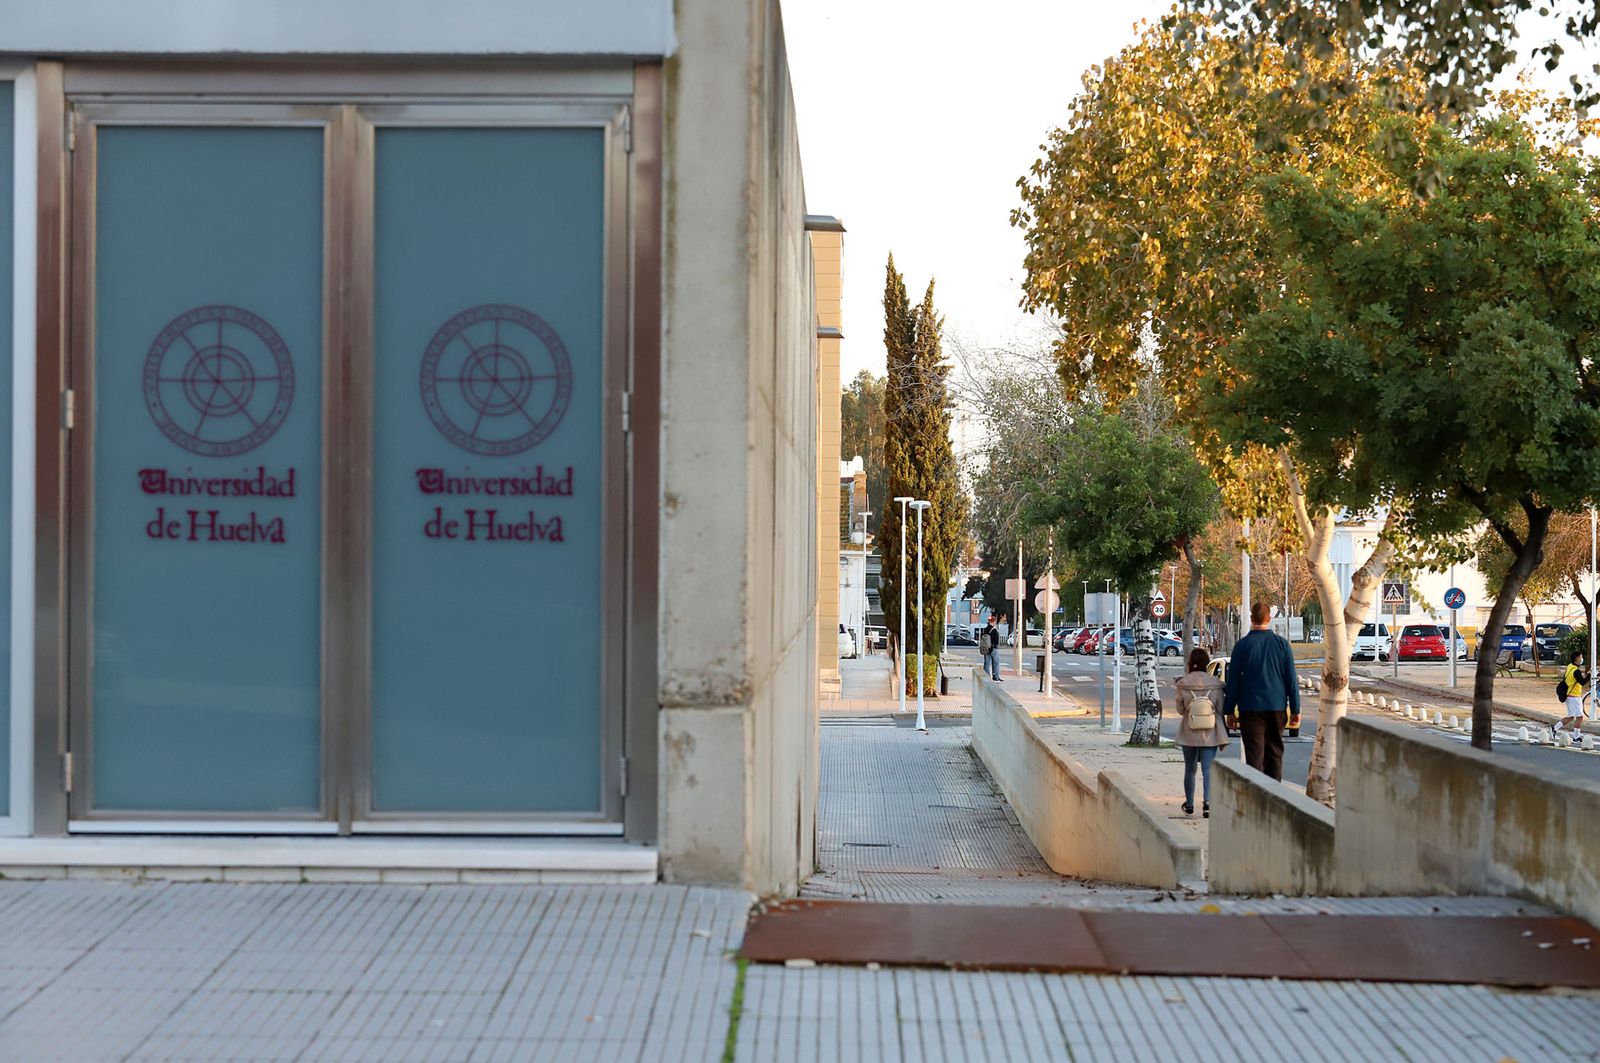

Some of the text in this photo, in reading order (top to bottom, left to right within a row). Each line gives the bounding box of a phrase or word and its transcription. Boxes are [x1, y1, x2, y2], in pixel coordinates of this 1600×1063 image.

[138, 466, 295, 497] Universidad
[415, 465, 573, 497] Universidad
[146, 507, 286, 544] de Huelva
[424, 507, 564, 543] de Huelva
